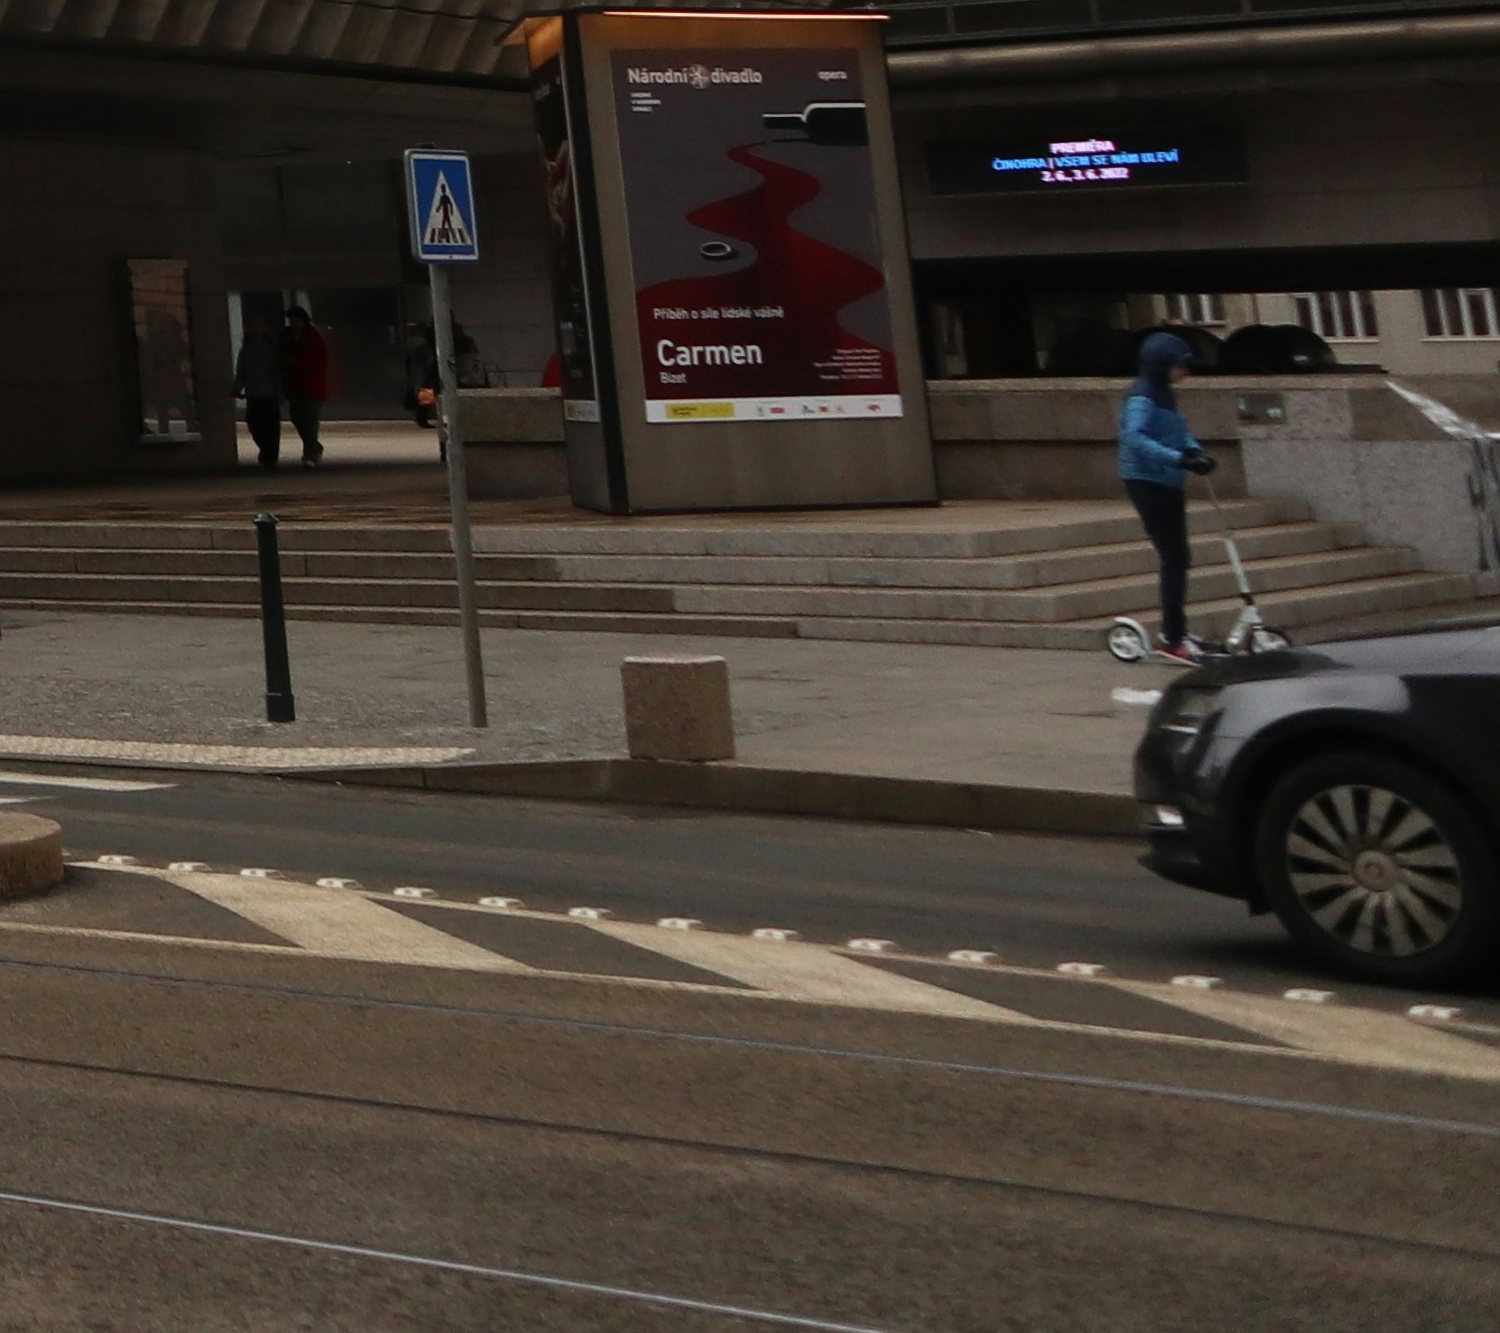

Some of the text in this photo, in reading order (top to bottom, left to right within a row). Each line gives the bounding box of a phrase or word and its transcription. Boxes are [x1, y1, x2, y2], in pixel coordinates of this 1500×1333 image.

[628, 67, 763, 84] Národní divadlo
[818, 70, 848, 81] opera
[1050, 139, 1115, 153] PREMIÉRA
[992, 156, 1047, 170] ČINOHRA
[1091, 154, 1109, 165] SE
[691, 310, 699, 319] o
[657, 339, 763, 367] Carmen
[660, 371, 687, 384] Bizet
